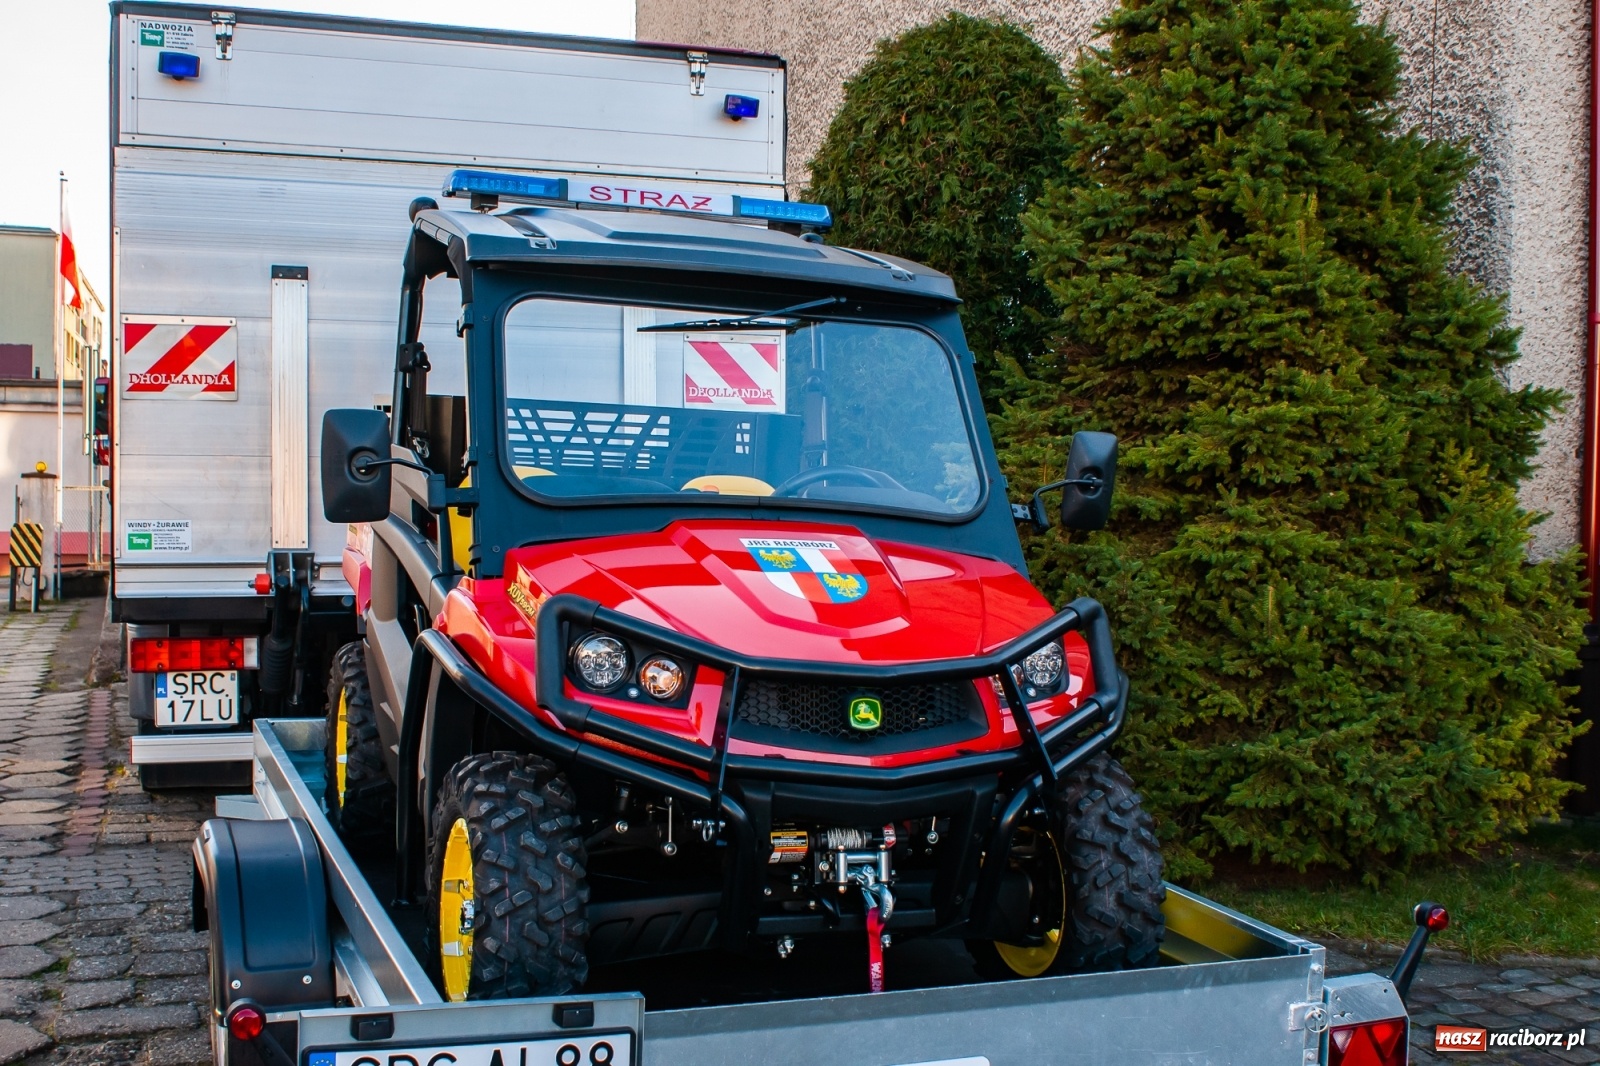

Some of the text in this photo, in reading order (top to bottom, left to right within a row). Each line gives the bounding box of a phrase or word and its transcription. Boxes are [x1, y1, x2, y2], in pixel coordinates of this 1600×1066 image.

[140, 21, 194, 32] NADWOZIA
[128, 373, 232, 385] DHOLLANDIA
[688, 386, 775, 399] DHOLLANDIA
[173, 672, 225, 695] SRC
[167, 698, 232, 723] 17LU
